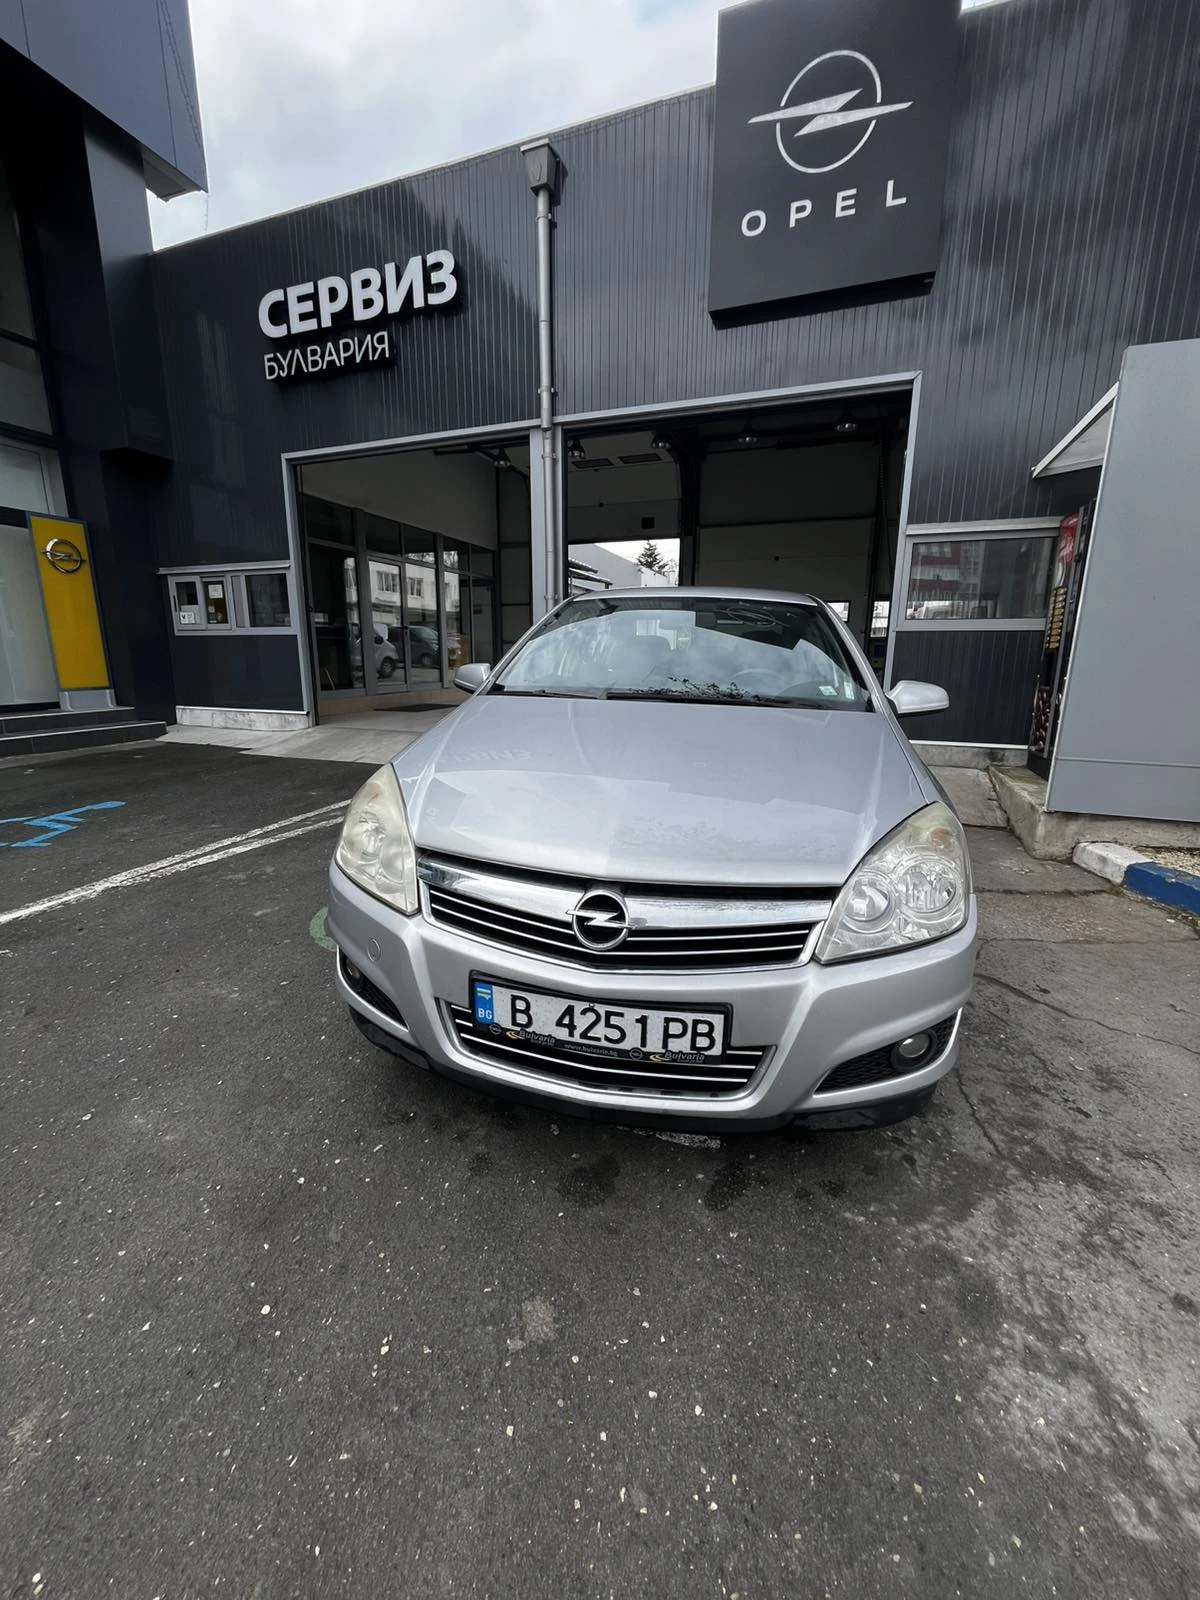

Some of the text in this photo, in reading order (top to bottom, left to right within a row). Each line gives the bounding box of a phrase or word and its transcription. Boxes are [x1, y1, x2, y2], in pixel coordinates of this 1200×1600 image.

[741, 179, 907, 237] OPEL
[258, 250, 458, 338] СЕРВИЗ
[264, 331, 390, 380] БУЛВАРИЯ
[478, 1007, 493, 1020] BG
[510, 994, 717, 1053] B 4251 PB
[519, 1029, 556, 1044] Bulvaria
[664, 1050, 705, 1062] Bulvaria
